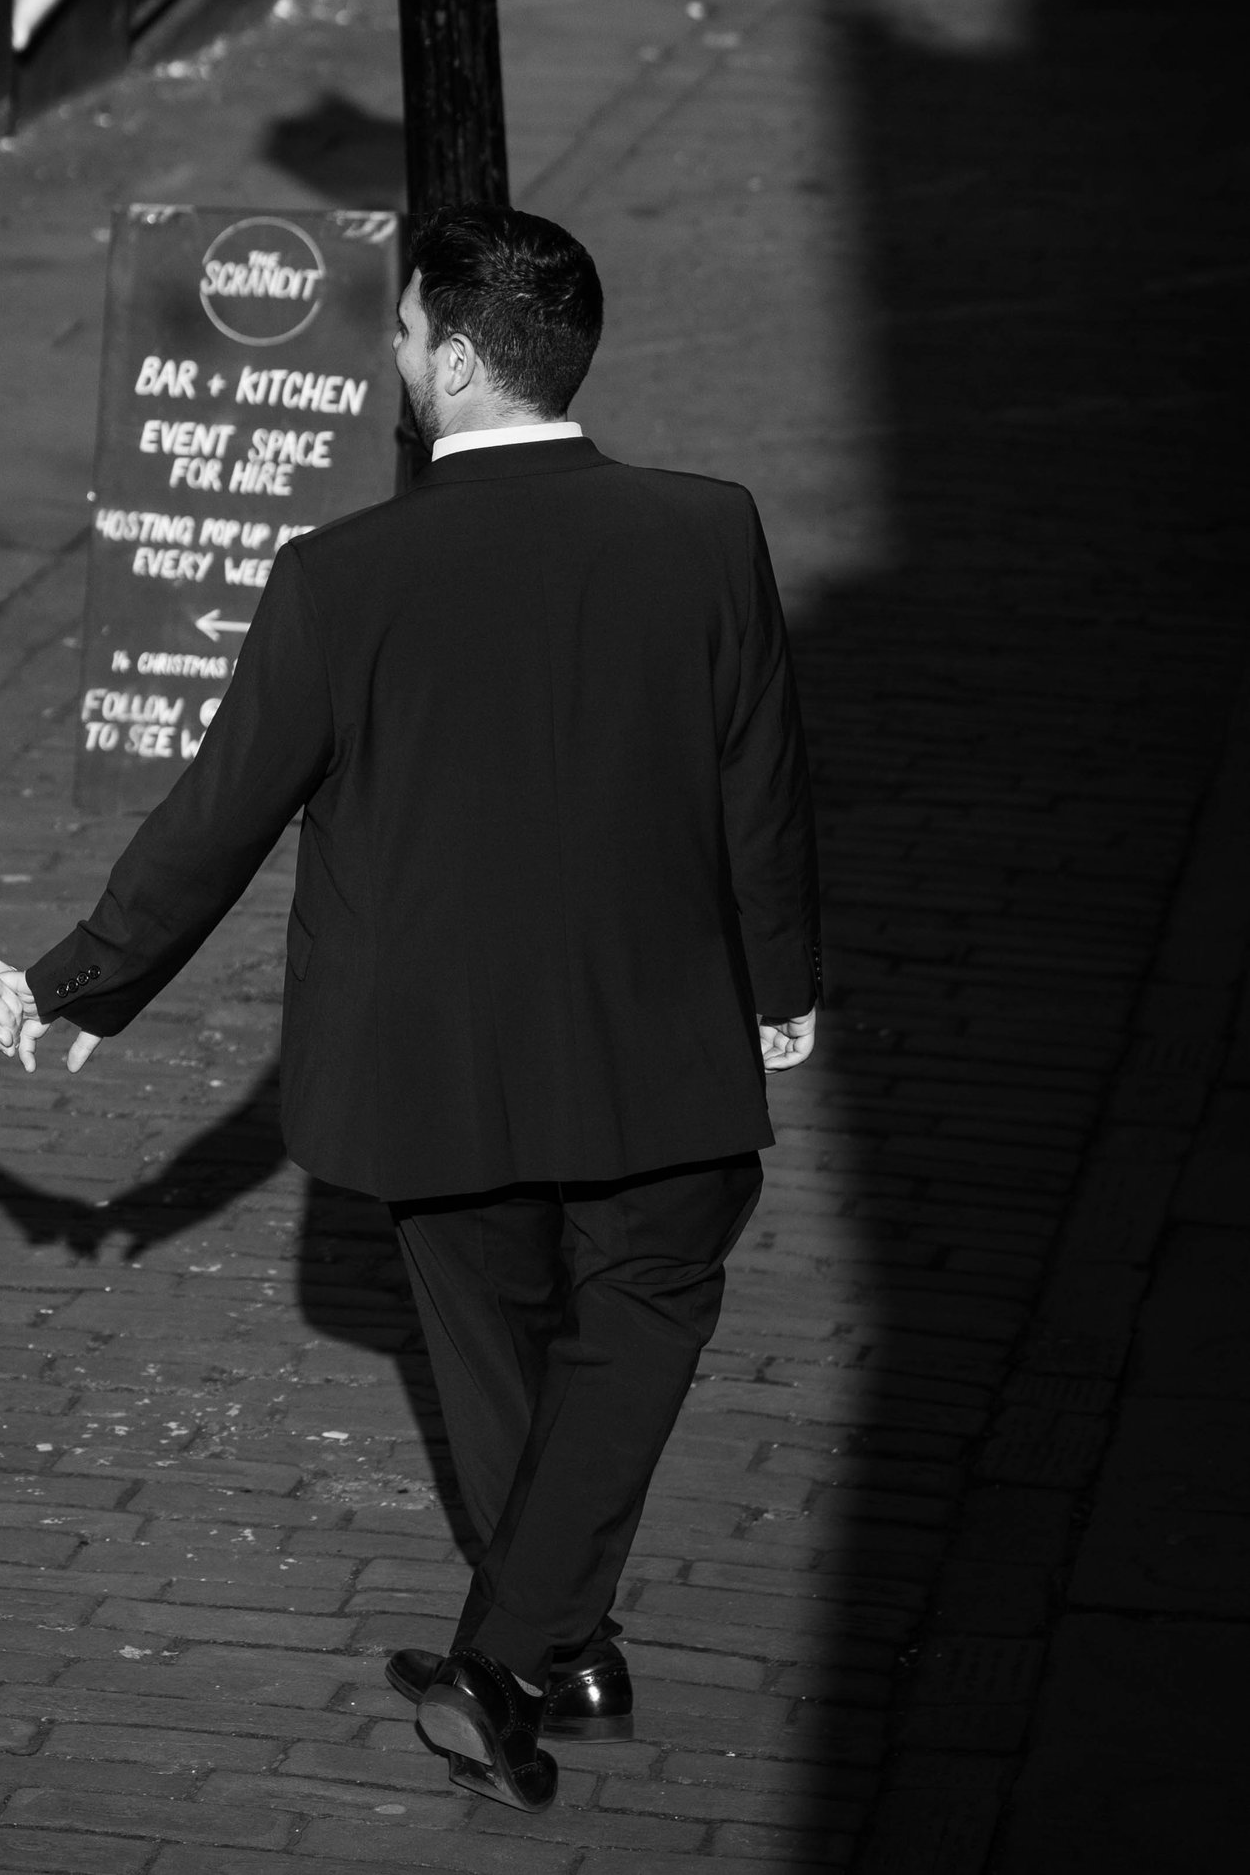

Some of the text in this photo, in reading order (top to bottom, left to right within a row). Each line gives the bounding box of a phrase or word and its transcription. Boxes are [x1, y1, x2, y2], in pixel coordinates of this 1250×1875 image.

[248, 250, 282, 269] THE
[200, 259, 321, 301] SCRANDIT
[135, 356, 198, 399] BAR
[235, 366, 368, 415] KITCHEN
[139, 419, 336, 469] EVENT SPACE
[169, 457, 295, 497] FOR HIRE
[96, 509, 196, 545] HOSTING
[198, 517, 241, 549] POP
[240, 521, 272, 550] UP
[132, 546, 273, 586] EVERY WEE
[137, 650, 229, 679] CHRISTMAS
[82, 688, 185, 726] FOLLOW
[84, 721, 121, 752] TO
[124, 724, 177, 759] SEE
